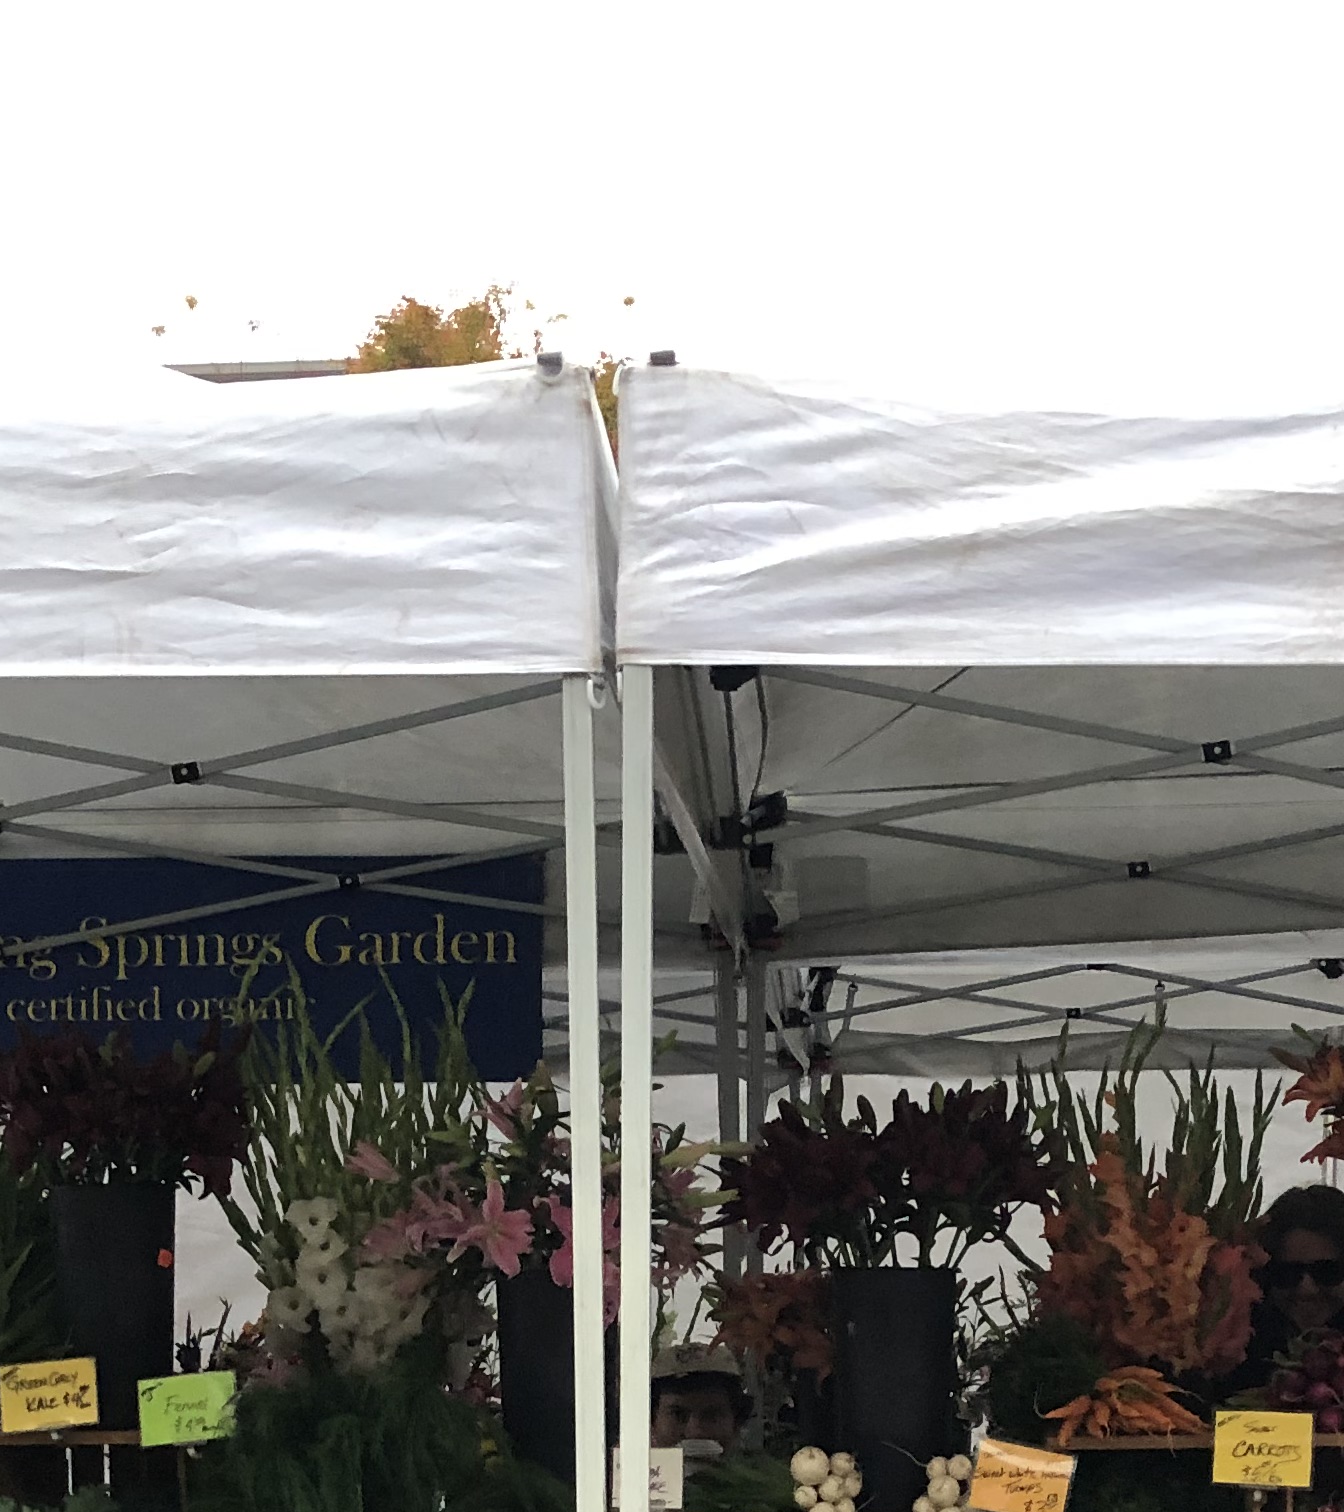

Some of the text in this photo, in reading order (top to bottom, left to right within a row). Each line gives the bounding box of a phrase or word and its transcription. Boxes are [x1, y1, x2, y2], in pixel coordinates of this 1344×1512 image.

[77, 916, 283, 980] Springs
[305, 913, 519, 966] Garden
[6, 985, 162, 1023] certified
[25, 1396, 60, 1413] KALE
